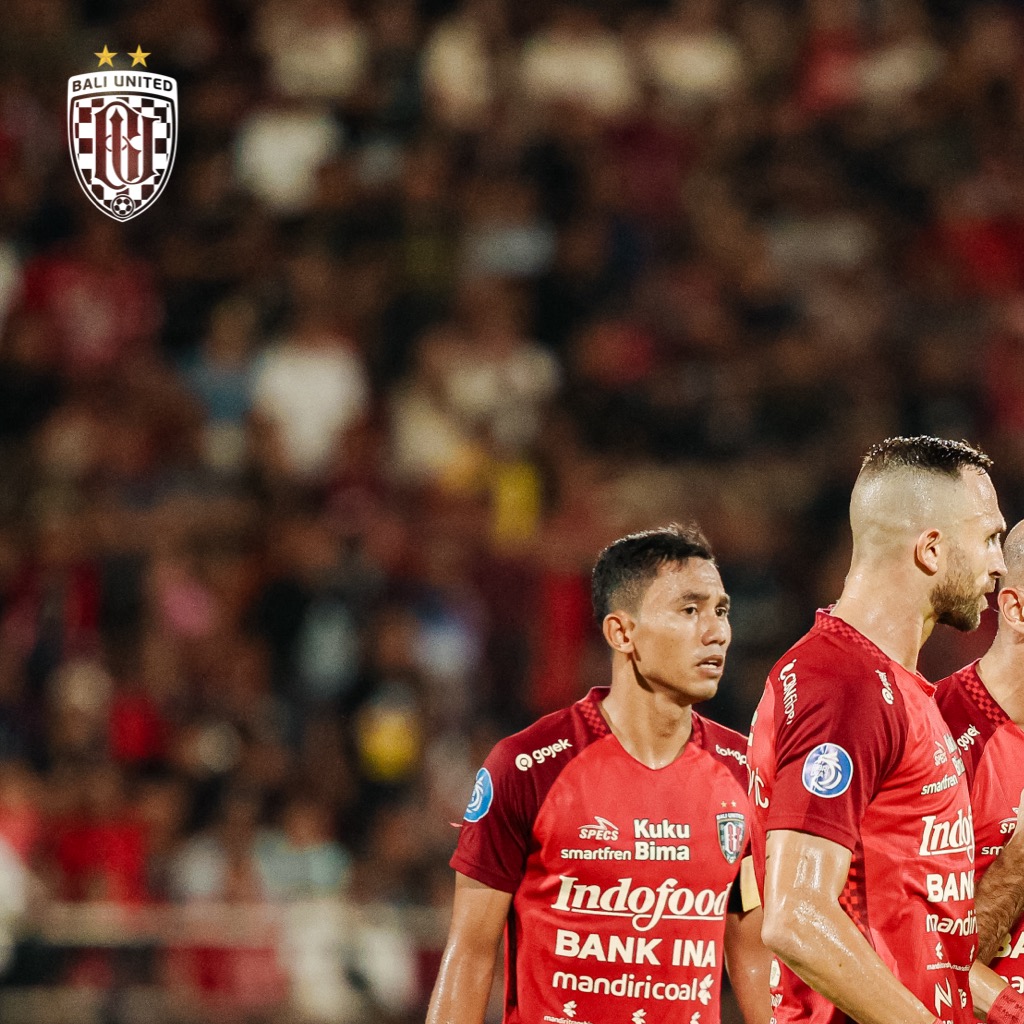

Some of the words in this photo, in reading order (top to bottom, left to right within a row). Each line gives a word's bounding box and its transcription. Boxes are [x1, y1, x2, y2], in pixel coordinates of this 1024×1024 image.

[957, 723, 981, 751] gojek
[532, 738, 573, 764] gojek
[920, 774, 958, 796] smartfren
[579, 828, 619, 841] SPECS
[633, 819, 691, 840] Kuku
[560, 847, 632, 861] smartfren
[634, 841, 690, 862] Bima
[551, 875, 732, 932] Indofood
[554, 928, 662, 966] BANK
[672, 939, 717, 968] INA
[552, 971, 698, 1001] mandiricoal
